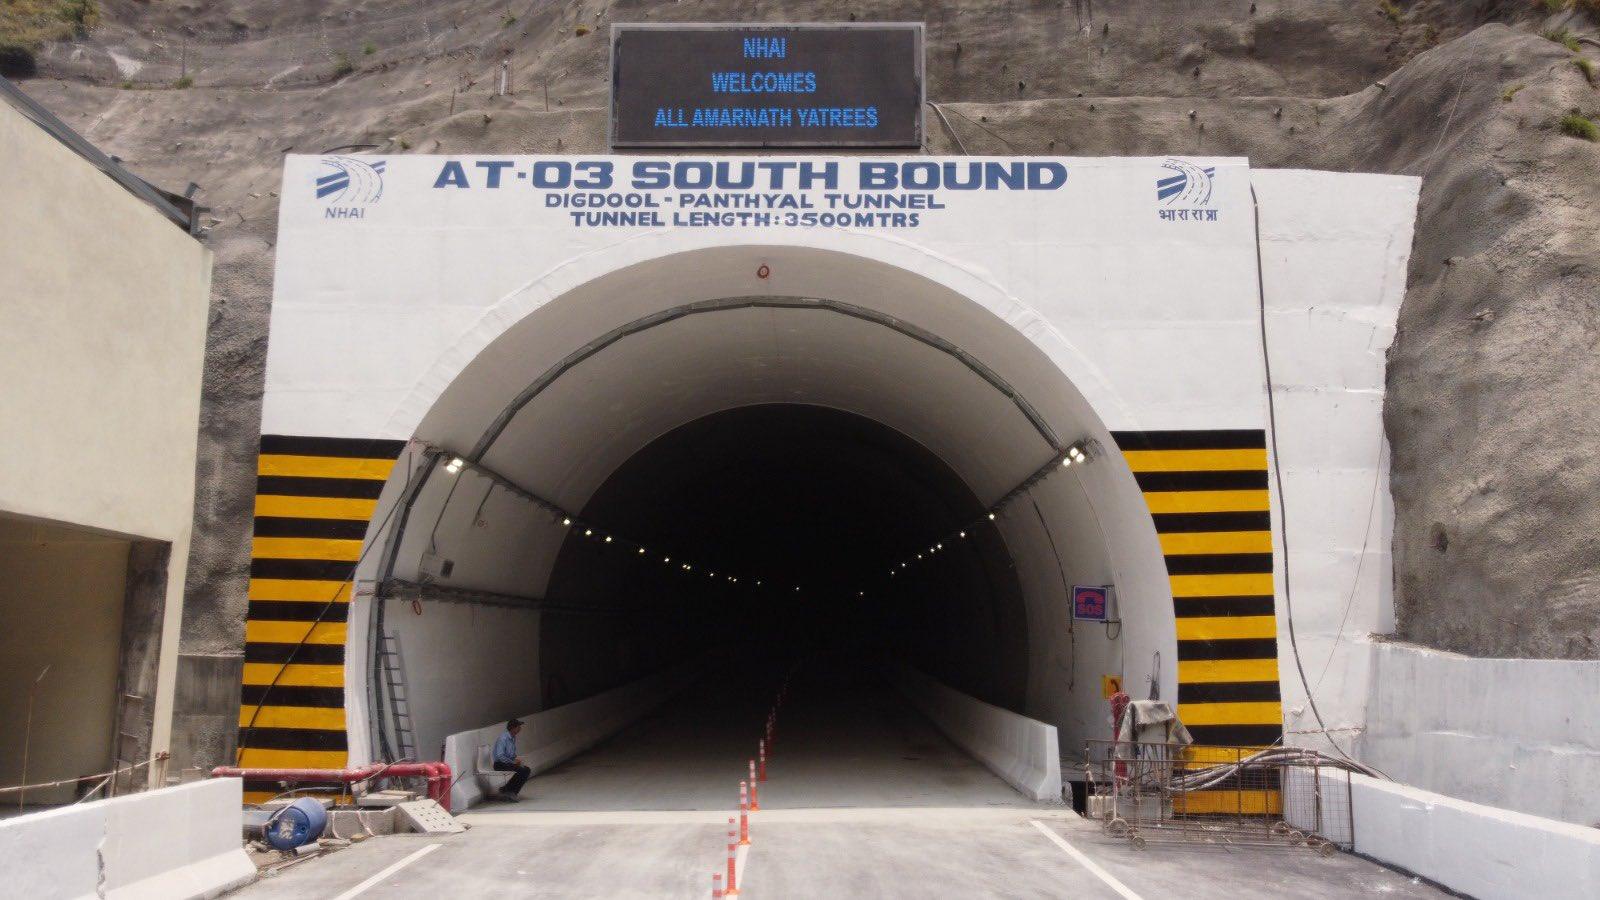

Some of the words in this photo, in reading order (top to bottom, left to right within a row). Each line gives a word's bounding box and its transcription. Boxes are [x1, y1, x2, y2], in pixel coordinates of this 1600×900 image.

[742, 37, 787, 59] NHAI
[711, 70, 817, 94] WELCOMES
[654, 107, 689, 128] ALL
[691, 106, 794, 128] AMARNATH
[796, 105, 881, 128] YATREES
[432, 161, 615, 189] AT-03
[631, 162, 839, 190] SOUTH
[858, 162, 1068, 190] BOUND
[823, 194, 946, 209] TUNNEL
[324, 208, 365, 218] NHAI
[569, 212, 666, 226] TUNNEL
